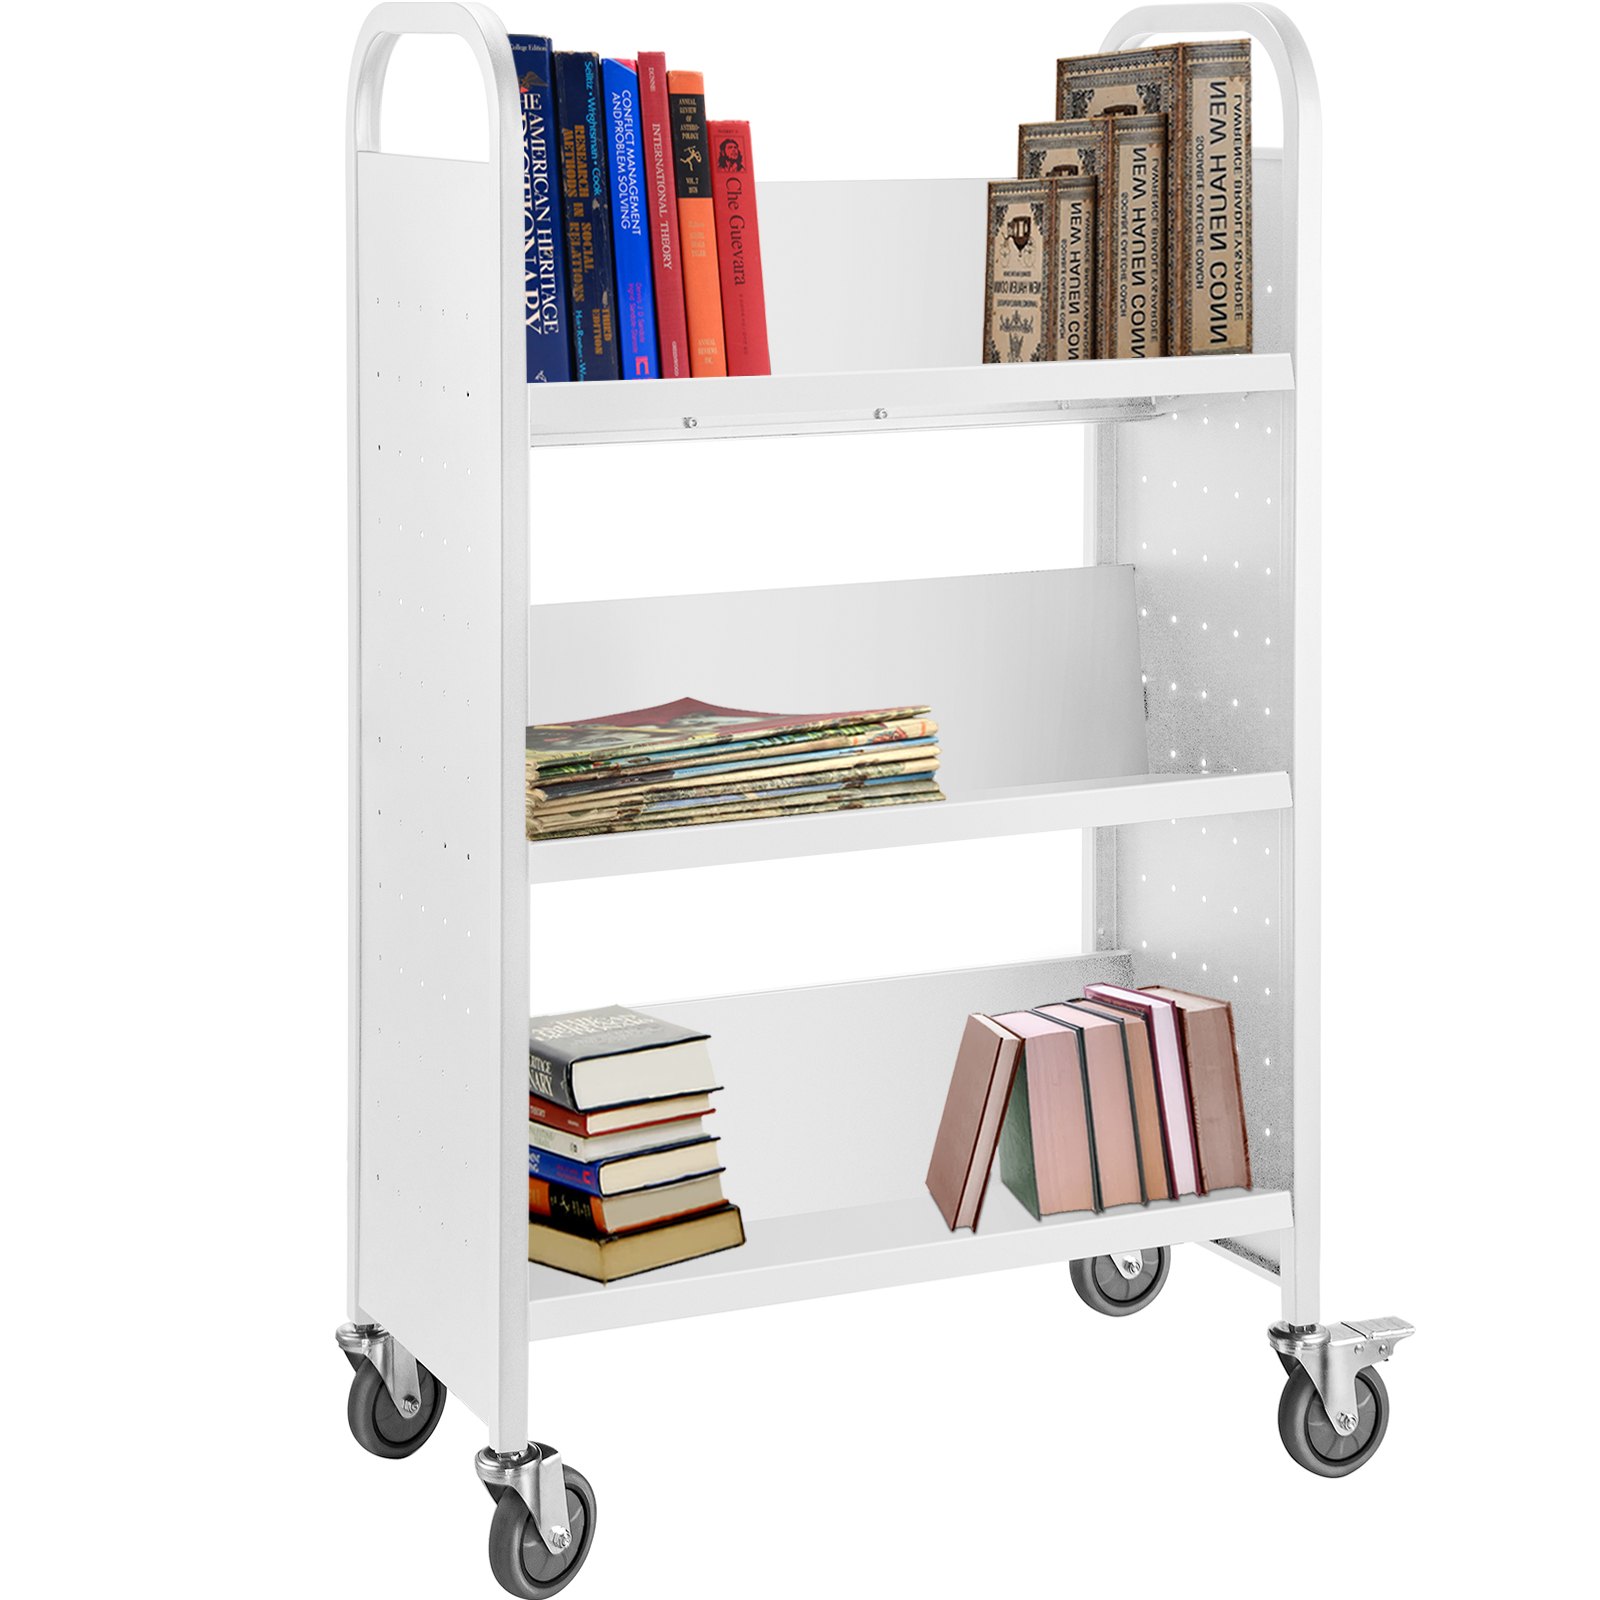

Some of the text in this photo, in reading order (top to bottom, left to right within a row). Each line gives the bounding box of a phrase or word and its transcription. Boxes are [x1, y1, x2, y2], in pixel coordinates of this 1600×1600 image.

[529, 112, 552, 221] AMERICAN
[562, 128, 577, 197] METHODS
[575, 125, 589, 197] RESEARCH
[586, 97, 598, 160] Wrightsman
[592, 168, 602, 196] Cook
[612, 92, 631, 230] AND PROBLEM SOLVING
[622, 90, 641, 235] CONFLICT MANAGEMENT
[573, 203, 584, 217] IN
[652, 123, 667, 218] INTERNATIONAL
[660, 222, 672, 269] THEORY
[726, 177, 742, 210] Che
[537, 229, 559, 334] HERITAGE
[569, 222, 585, 302] RELATIONS
[582, 222, 594, 273] SOCIAL
[729, 216, 746, 285] Guevara
[592, 309, 603, 355] EDITION
[602, 309, 612, 341] THIRD
